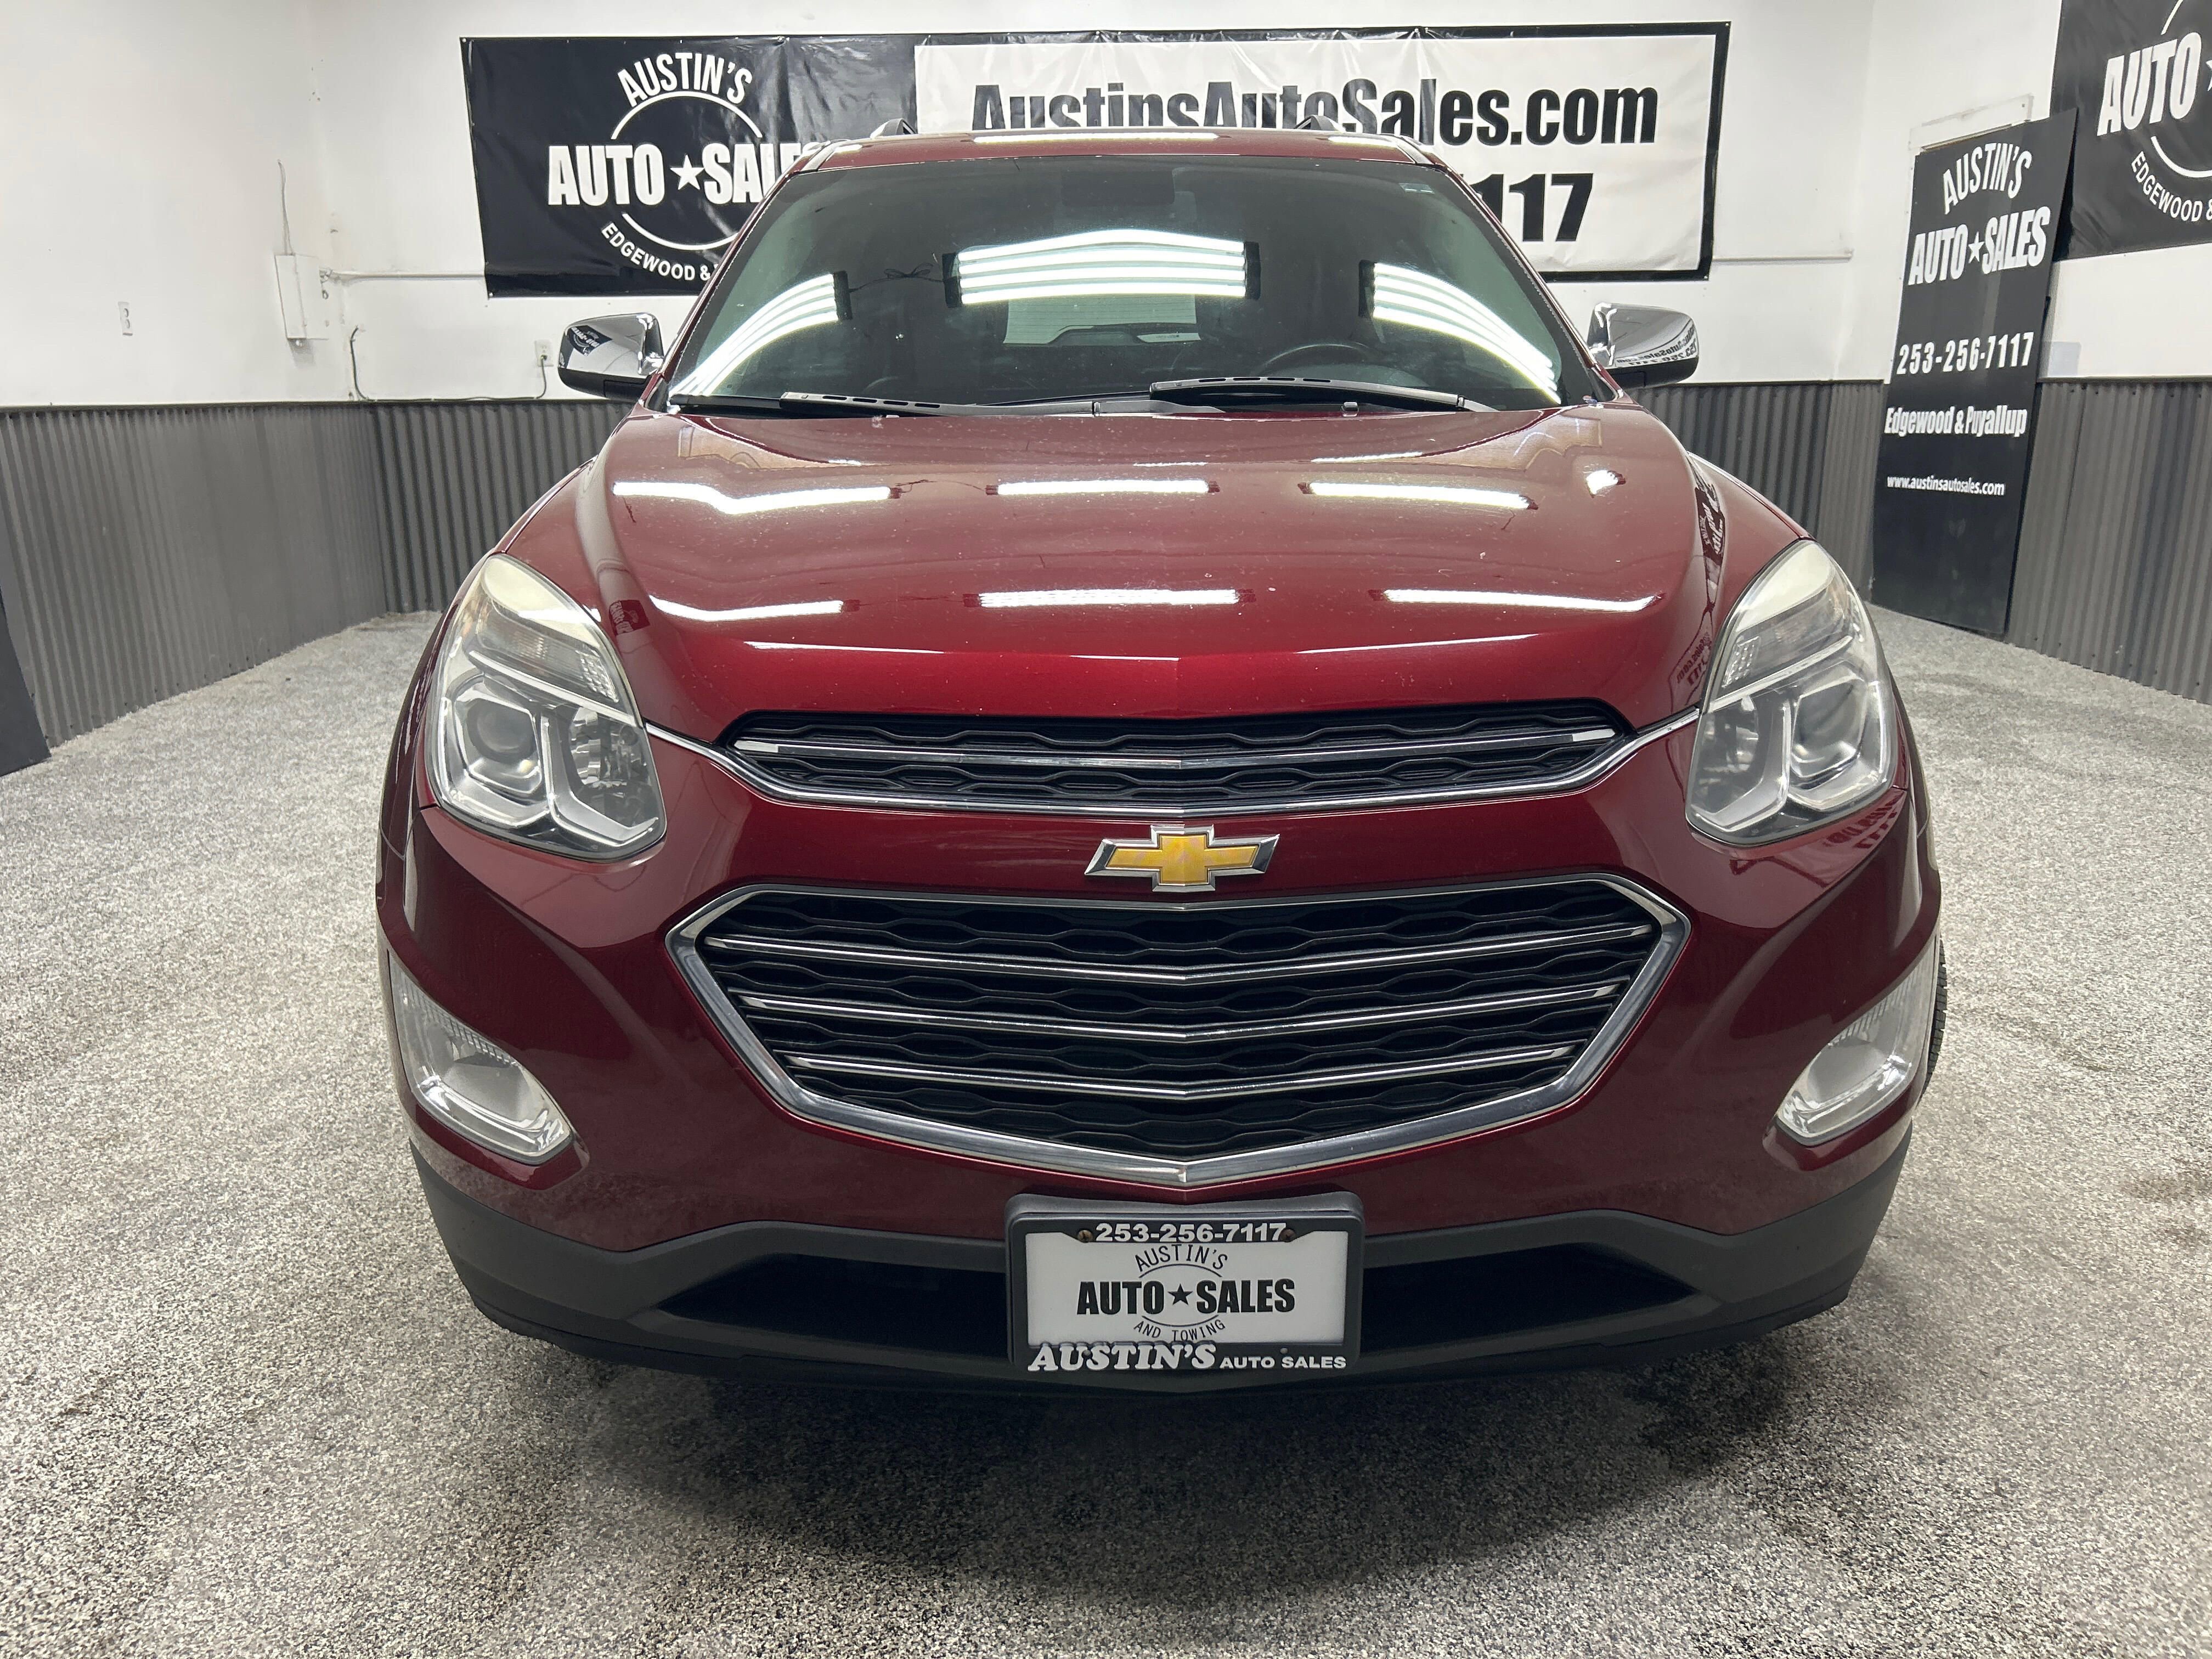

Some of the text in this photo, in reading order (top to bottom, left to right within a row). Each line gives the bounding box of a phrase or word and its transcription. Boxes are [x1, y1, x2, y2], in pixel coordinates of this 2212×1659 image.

[617, 52, 752, 107] AUSTIN'S
[2097, 32, 2202, 137] AUTO
[549, 142, 823, 206] AUTO SAL
[1943, 142, 2032, 215] AUSTIN'S
[2131, 151, 2203, 222] EDGEWOOD
[601, 222, 711, 281] EDGEWOOD &
[1908, 206, 2051, 285] AUTO SALES
[1897, 332, 2034, 375] 253-256-7117
[1884, 405, 2028, 437] Edgewood & Puyallup
[1887, 475, 2005, 496] www.austinsautosales.com
[1096, 1222, 1287, 1243] 253-256-7117
[1134, 1243, 1228, 1272] AUSTIN'S
[1076, 1279, 1295, 1315] AUTO SALES
[1133, 1318, 1226, 1342] AND TOWING
[1028, 1342, 1346, 1372] AUSTIN'S AUTO SALES
